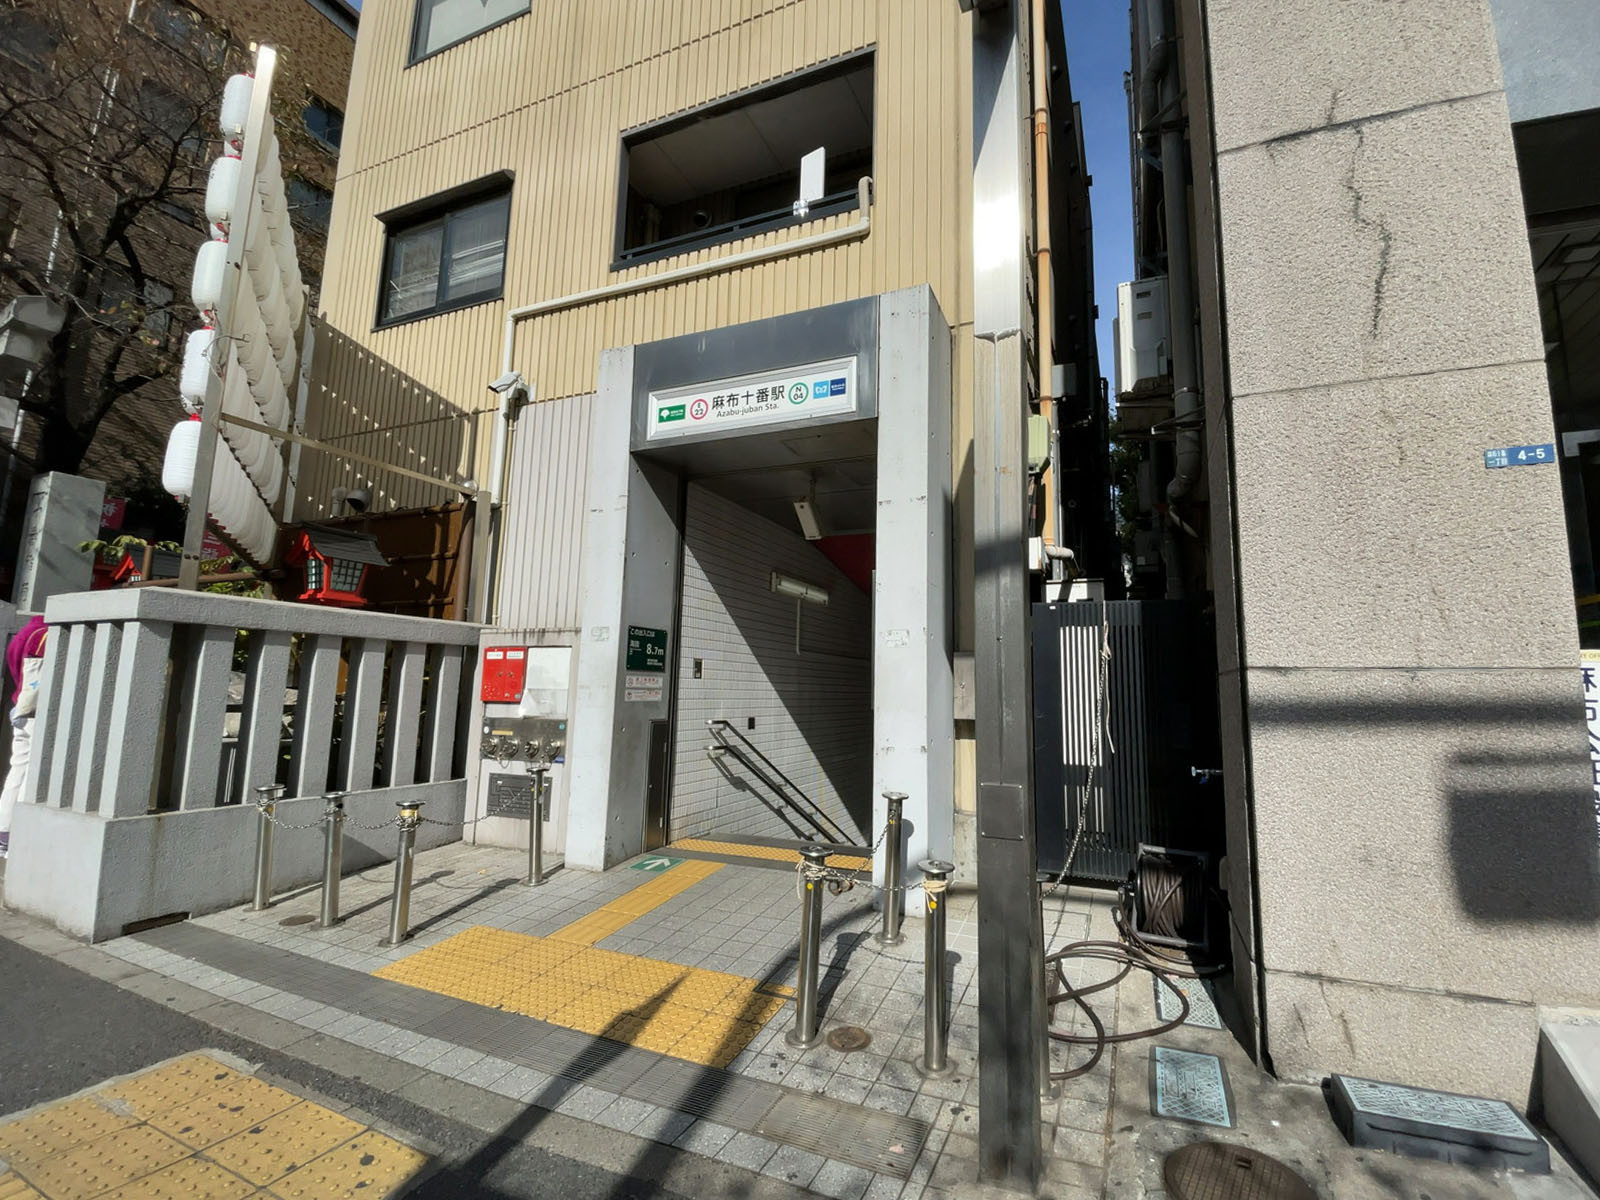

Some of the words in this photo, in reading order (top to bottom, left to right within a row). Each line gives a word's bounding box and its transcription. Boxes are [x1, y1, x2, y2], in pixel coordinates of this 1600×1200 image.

[712, 385, 785, 410] 麻布十番駅
[716, 405, 763, 418] Azabu-juban
[765, 403, 780, 411] Sta.
[1518, 448, 1545, 460] 4-5
[646, 643, 664, 655] 8.7m
